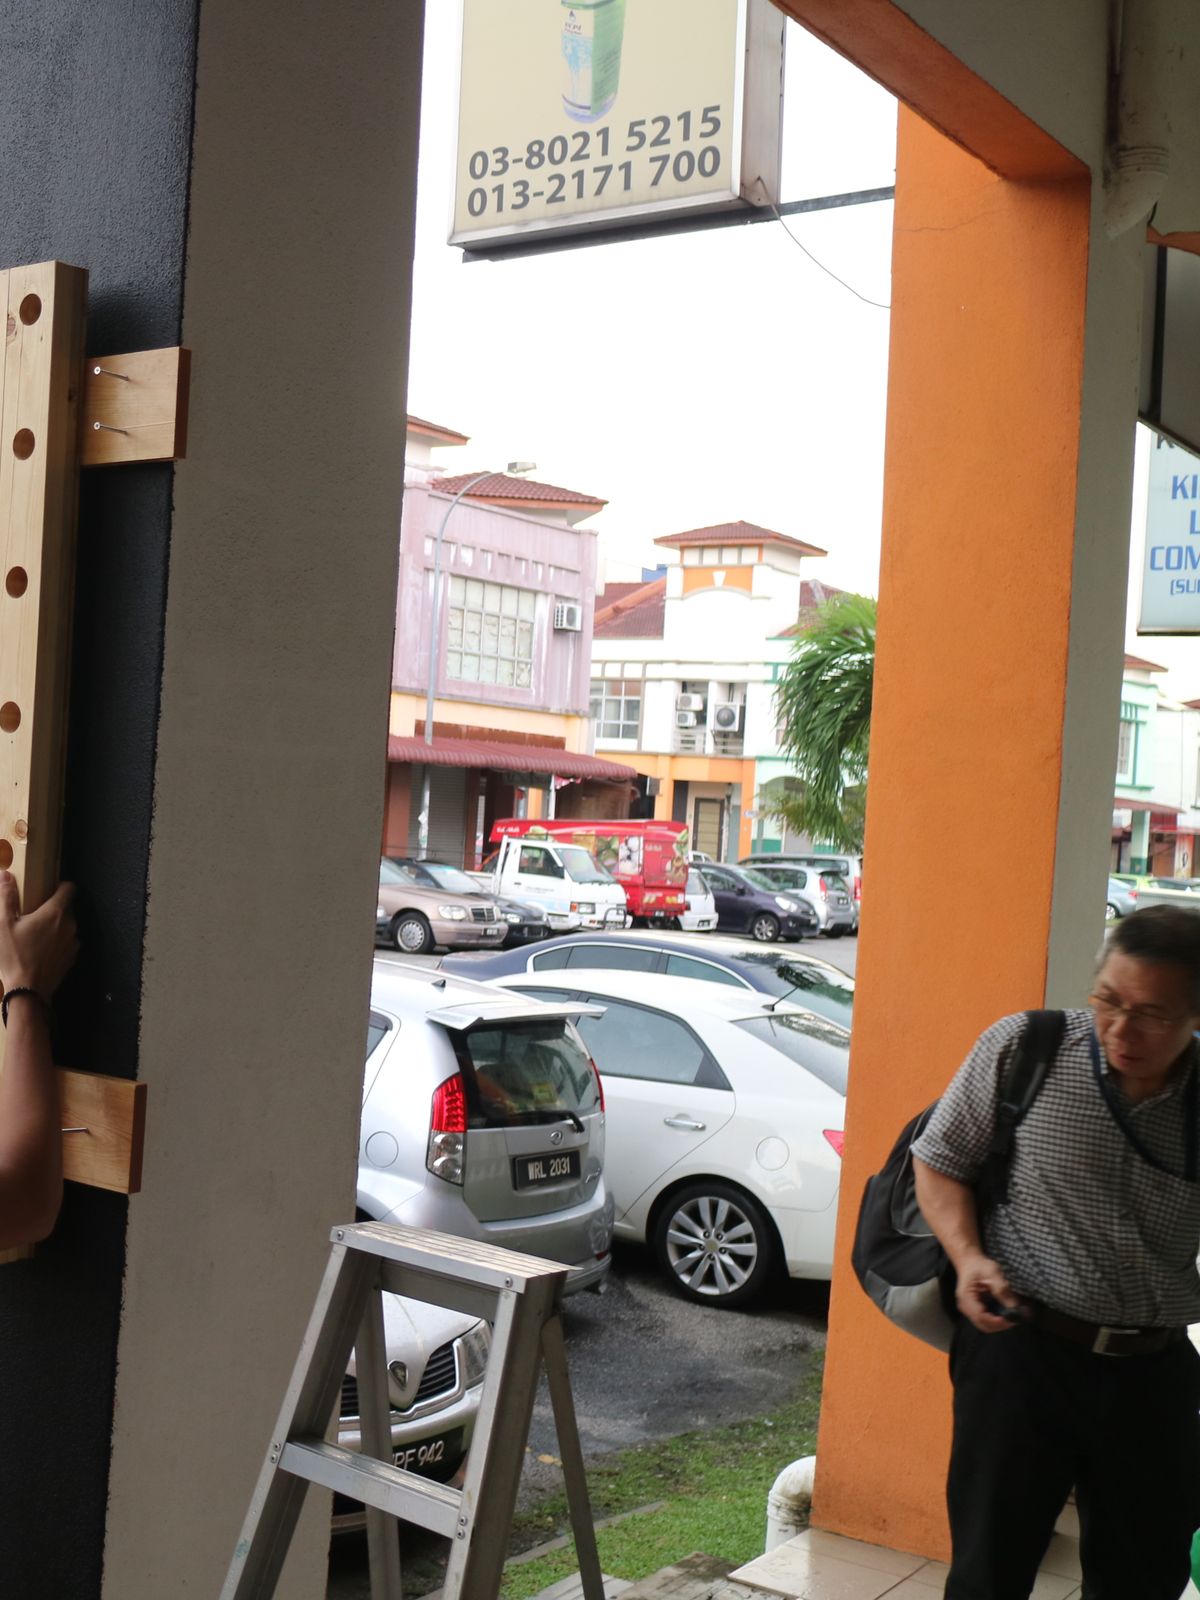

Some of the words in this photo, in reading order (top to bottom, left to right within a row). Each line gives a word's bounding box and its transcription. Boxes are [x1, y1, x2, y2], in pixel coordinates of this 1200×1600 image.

[469, 127, 611, 180] 03-8021
[626, 105, 722, 152] 5215
[467, 161, 633, 217] 013-2171
[650, 145, 721, 187] 700
[527, 1161, 547, 1180] WRL
[549, 1156, 570, 1177] 2031
[392, 1447, 416, 1470] PF
[417, 1440, 445, 1466] 942
